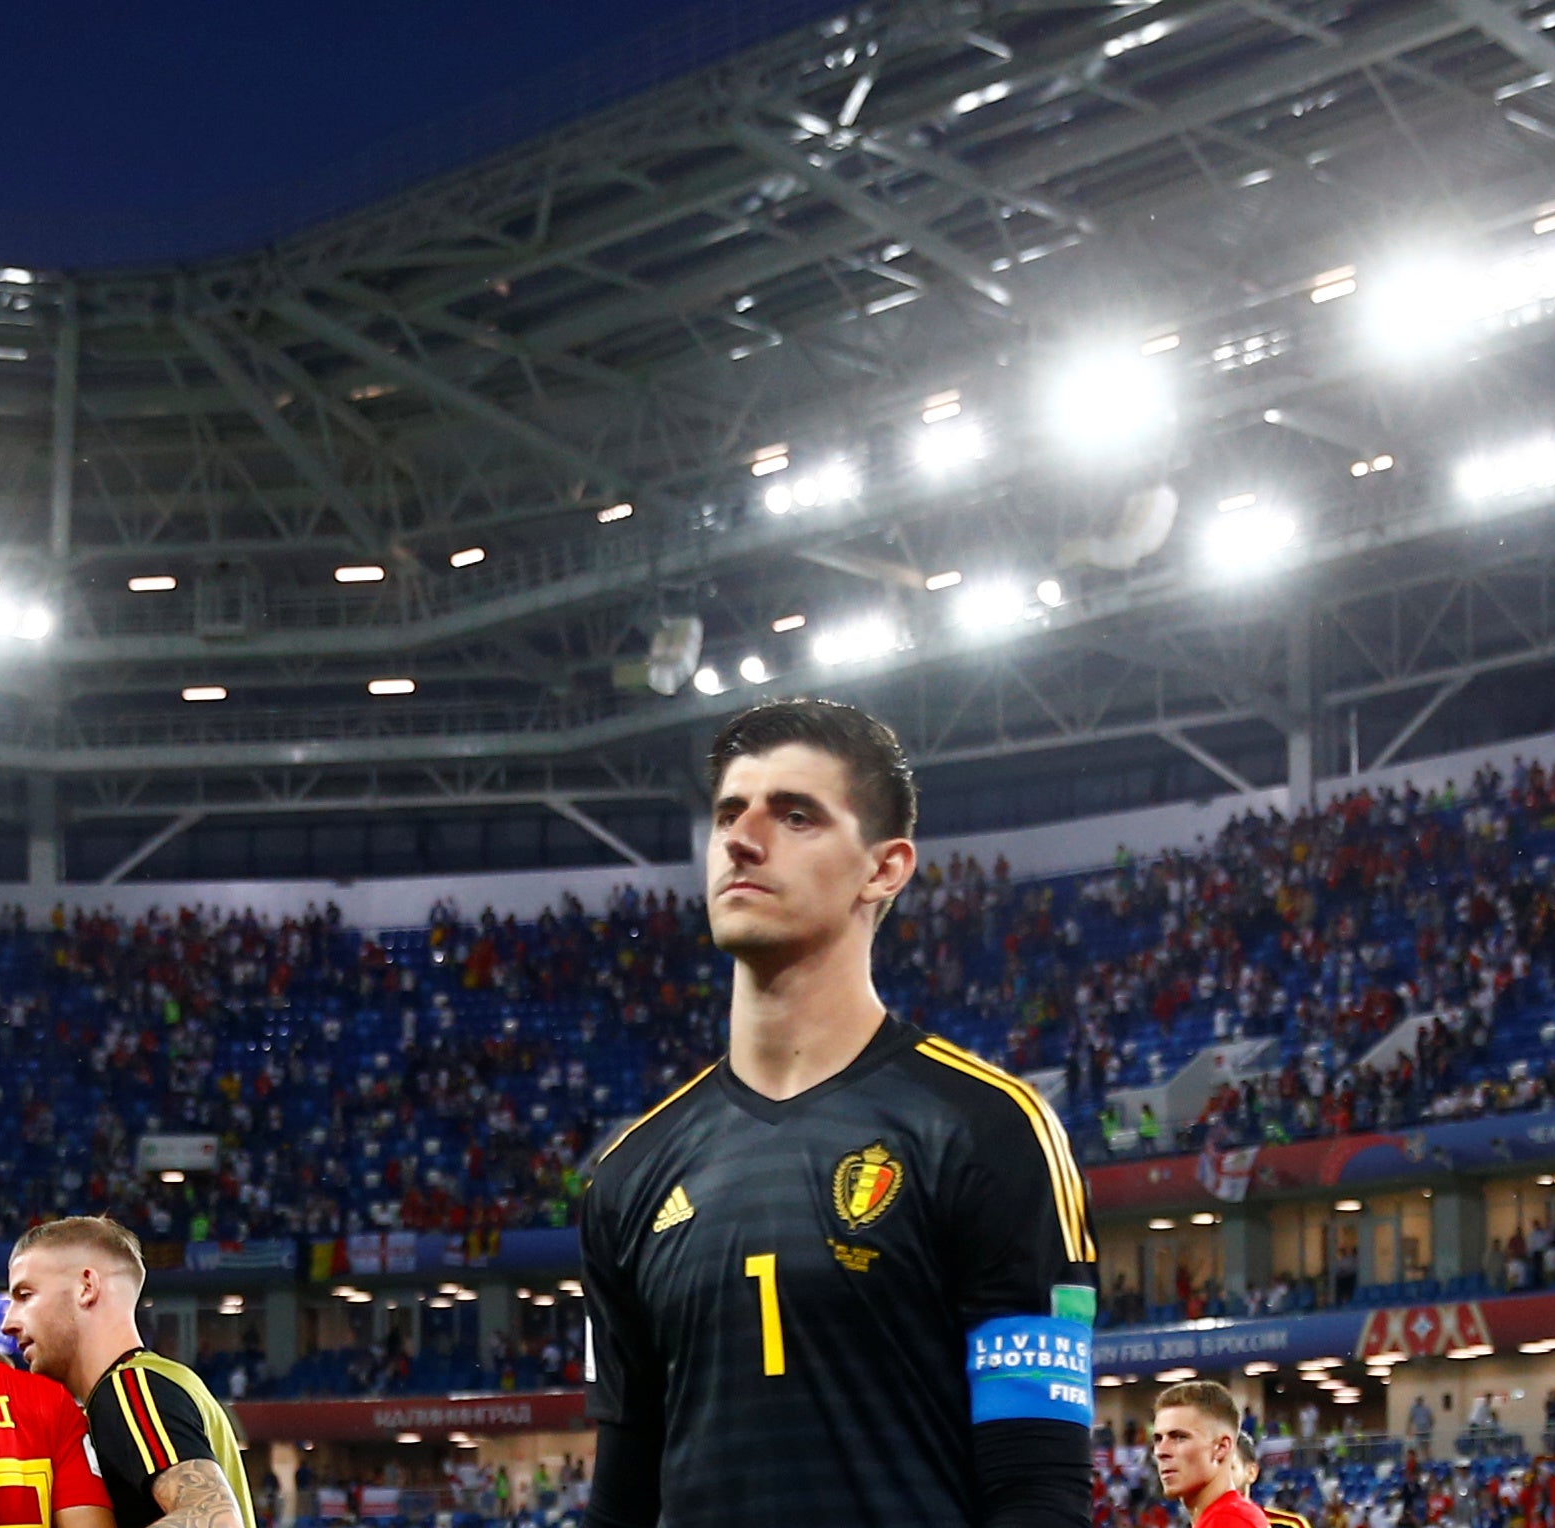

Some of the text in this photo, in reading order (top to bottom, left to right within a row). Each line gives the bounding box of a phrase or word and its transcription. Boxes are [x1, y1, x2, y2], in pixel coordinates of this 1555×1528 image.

[744, 1253, 785, 1376] 1
[975, 1334, 1089, 1358] LIVING
[975, 1351, 1089, 1374] FOOTBALL
[1049, 1383, 1089, 1406] FIFA
